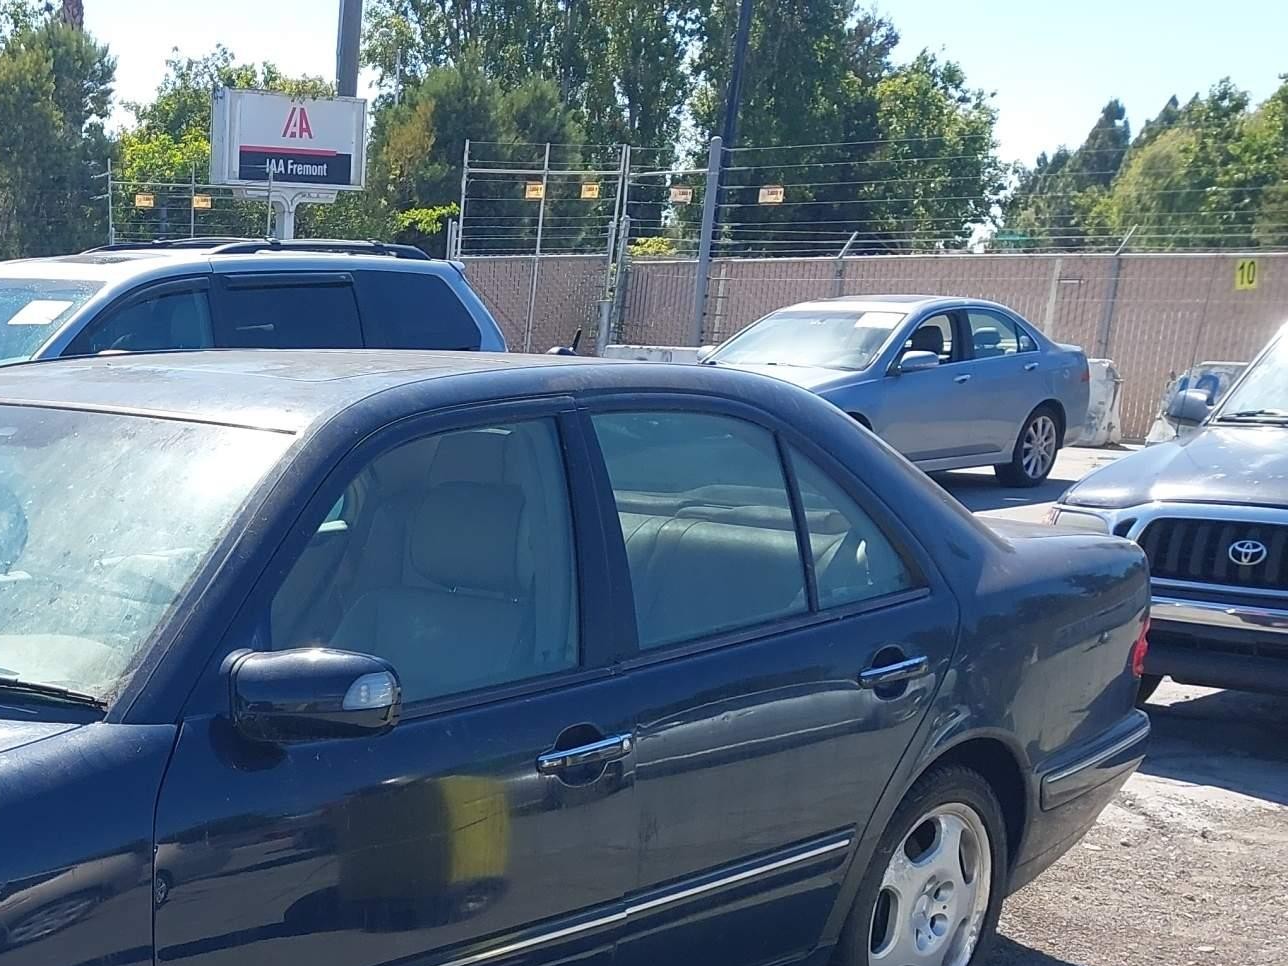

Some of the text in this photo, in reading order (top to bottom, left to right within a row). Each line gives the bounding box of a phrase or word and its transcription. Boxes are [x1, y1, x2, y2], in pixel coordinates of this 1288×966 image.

[266, 158, 328, 177] IAA Fremont
[1238, 261, 1256, 285] 10
